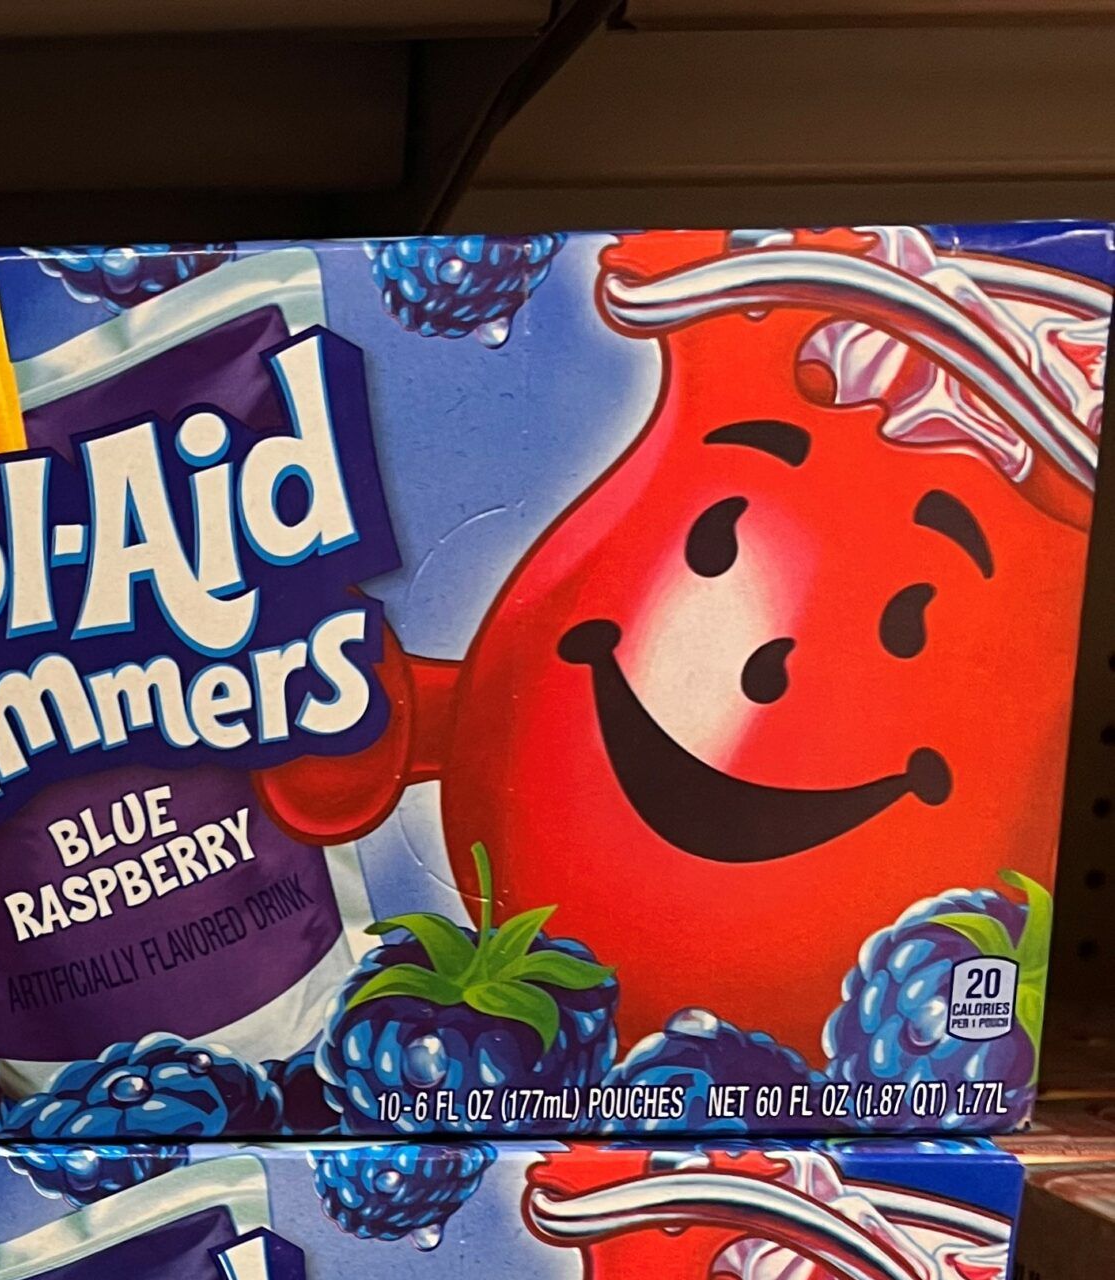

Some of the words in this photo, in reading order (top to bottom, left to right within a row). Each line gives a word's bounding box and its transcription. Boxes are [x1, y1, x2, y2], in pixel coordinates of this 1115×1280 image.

[48, 785, 177, 867] BLUE
[4, 808, 255, 942] RASPBERRY
[7, 944, 139, 1013] ARTIFICIALLY
[140, 905, 246, 975] FLAVORED
[245, 873, 315, 931] DRINK
[965, 968, 1001, 999] 20
[952, 1002, 1010, 1016] CALORIES
[436, 1091, 459, 1121] FL
[468, 1090, 493, 1120] OZ
[501, 1088, 580, 1121] (177mL)
[588, 1087, 684, 1118] POUCHES
[708, 1086, 749, 1116] NET
[756, 1086, 782, 1116] 60
[790, 1085, 813, 1116] FL
[822, 1084, 849, 1116] OZ
[856, 1084, 905, 1117] (1.87
[913, 1083, 947, 1117] QT)
[956, 1083, 1007, 1114] 1.77L
